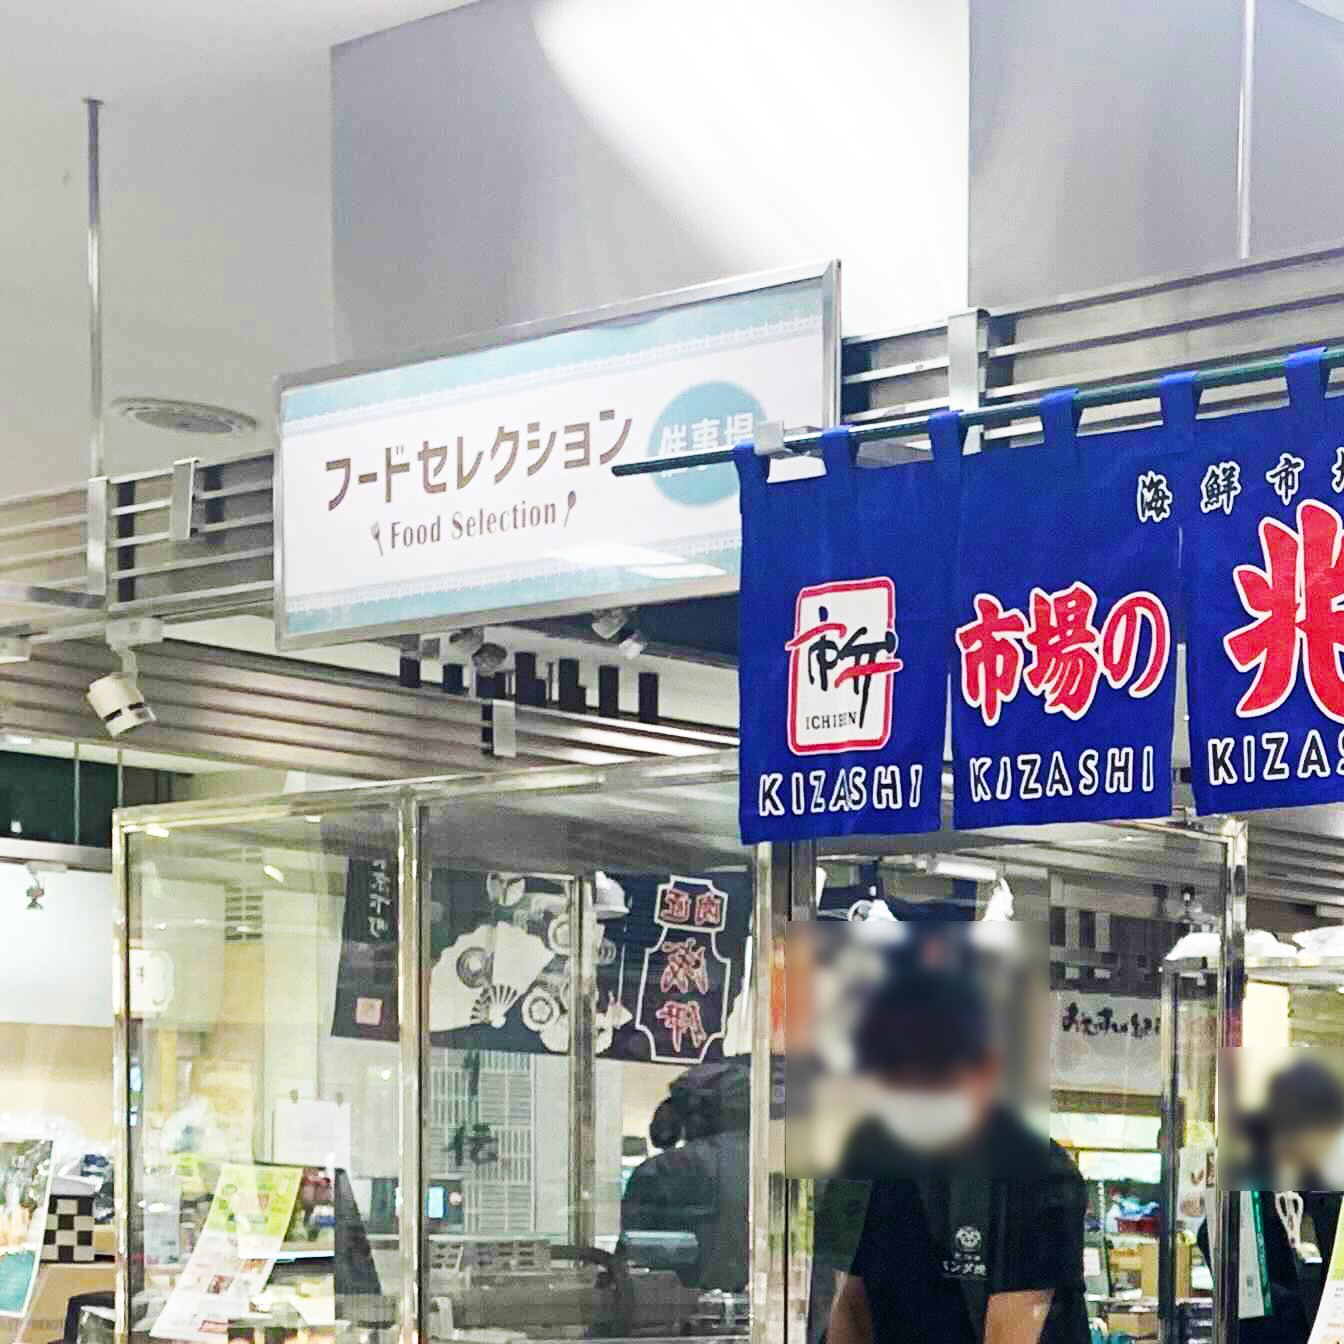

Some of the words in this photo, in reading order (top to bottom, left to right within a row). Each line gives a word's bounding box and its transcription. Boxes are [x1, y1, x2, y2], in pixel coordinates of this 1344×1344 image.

[325, 408, 634, 512] フードセレクション
[389, 517, 443, 551] Food
[451, 499, 558, 543] Selection
[956, 581, 1170, 727] 市場の
[758, 764, 924, 817] KIZASHI
[968, 745, 1155, 803] KIZASHI
